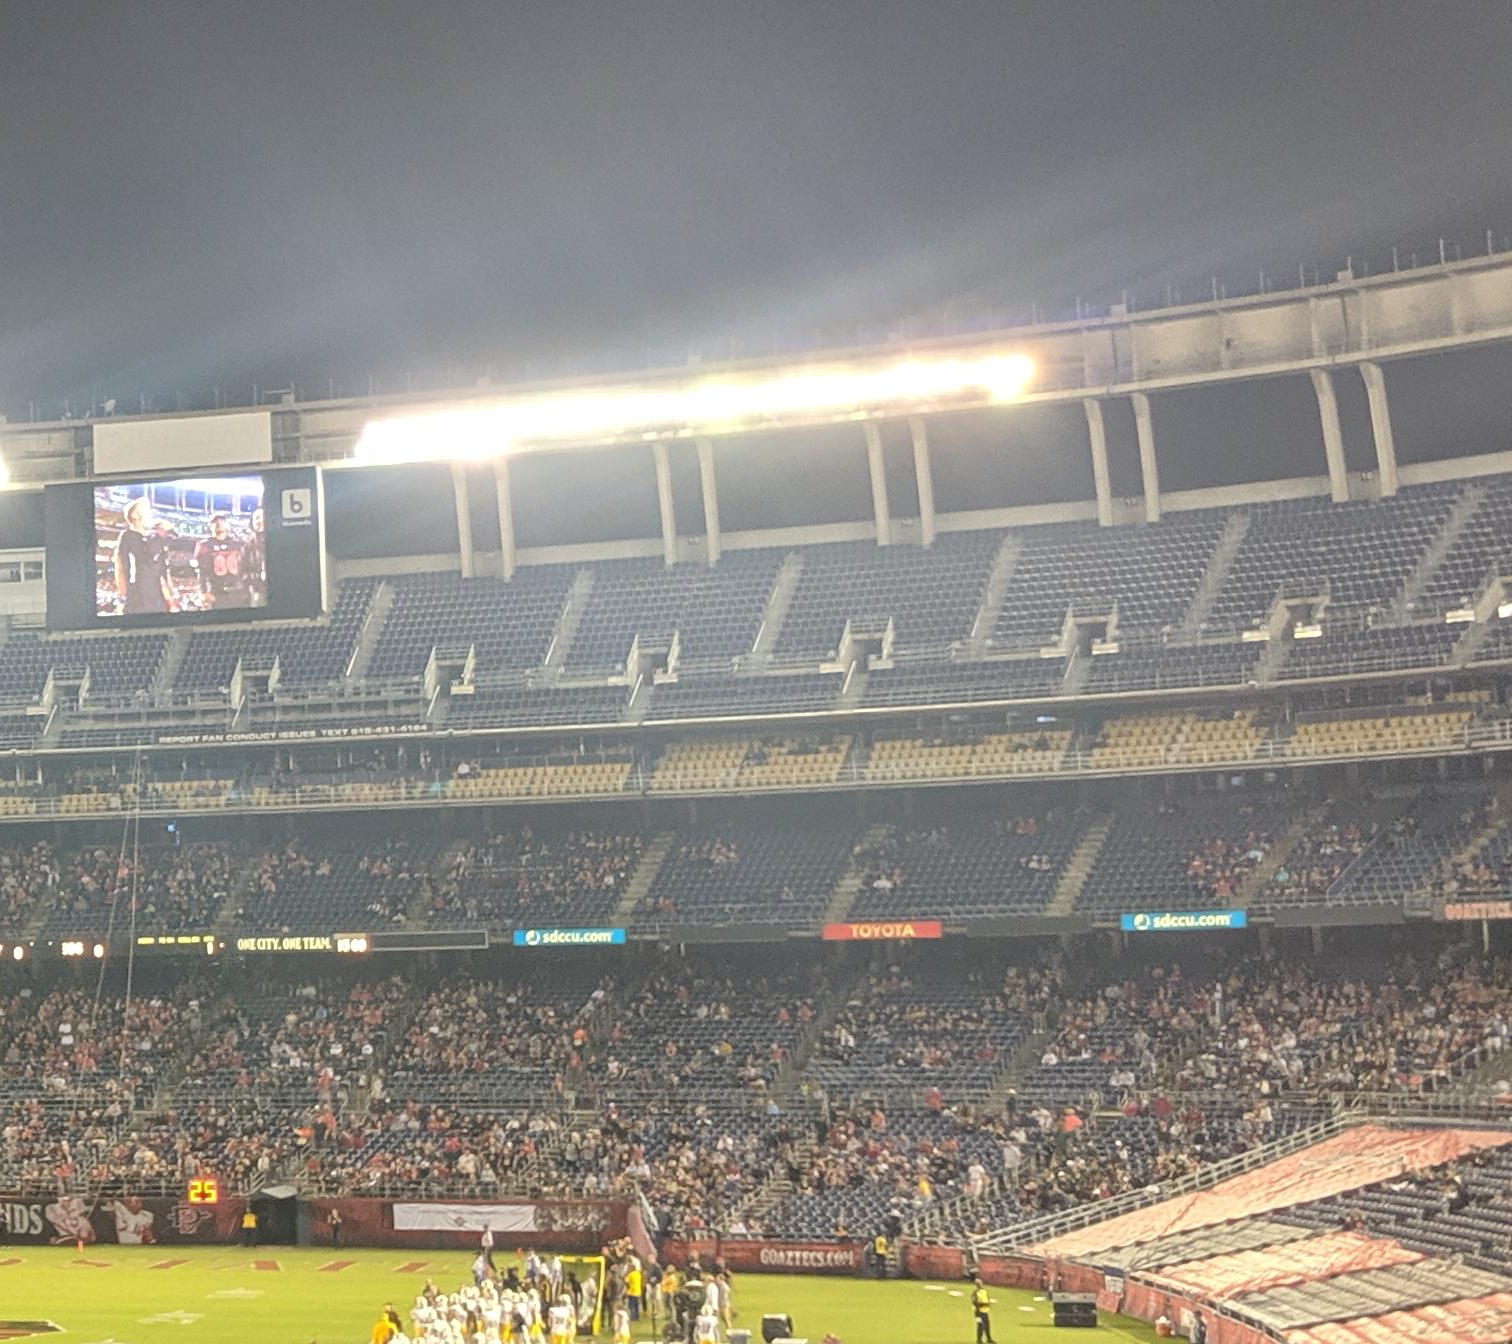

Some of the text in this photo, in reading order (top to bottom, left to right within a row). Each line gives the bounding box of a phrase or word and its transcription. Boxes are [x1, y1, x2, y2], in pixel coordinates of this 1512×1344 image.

[202, 734, 223, 743] FAN
[225, 732, 277, 742] CONDUCT
[320, 728, 348, 737] TEXT
[1153, 913, 1231, 928] sdccu.com
[543, 929, 612, 944] sdccu.com
[849, 923, 916, 938] TOYOTA
[237, 938, 256, 950] ONE
[282, 937, 301, 950] ONE
[189, 1180, 218, 1204] 25
